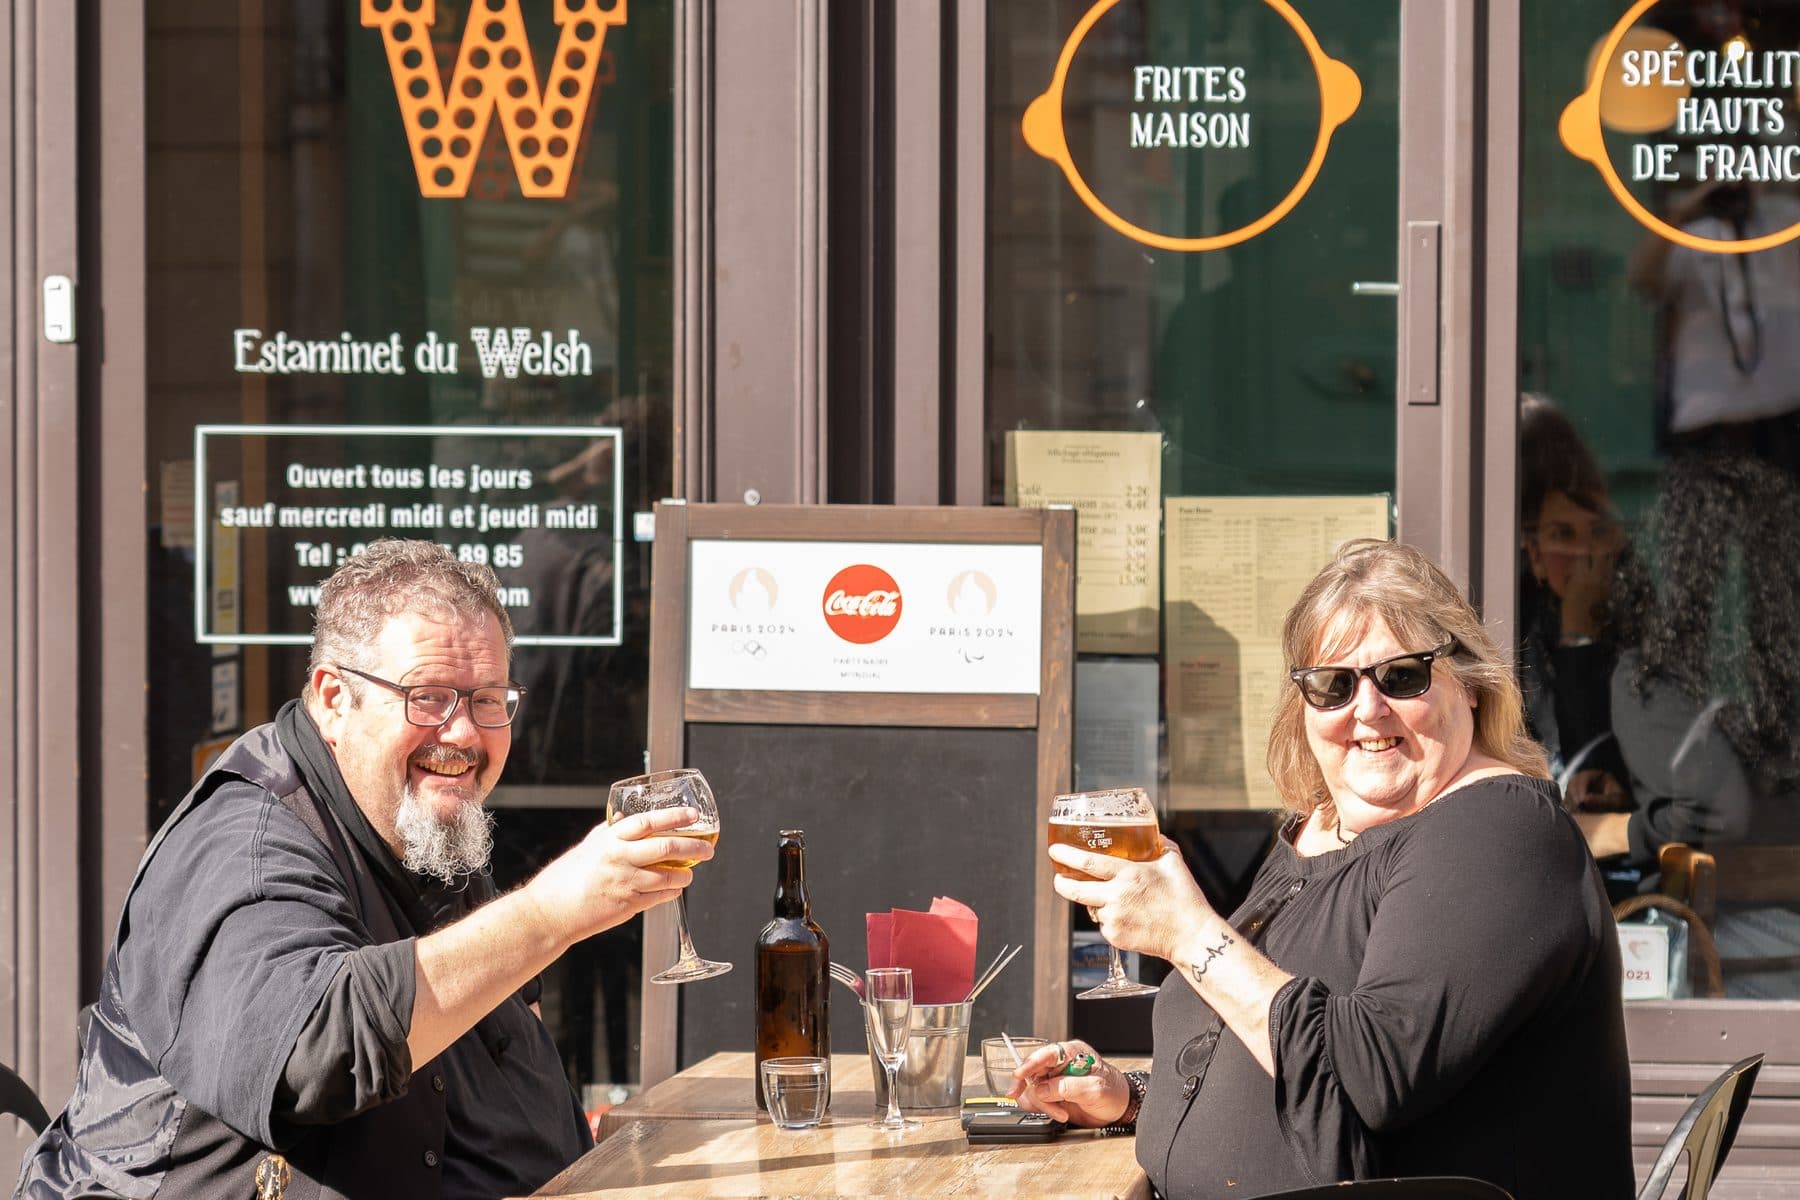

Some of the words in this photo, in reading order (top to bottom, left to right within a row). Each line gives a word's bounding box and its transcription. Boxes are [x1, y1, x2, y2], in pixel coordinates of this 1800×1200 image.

[1622, 42, 1800, 87] SPÉCIALIT
[360, 0, 628, 198] W
[1133, 65, 1247, 103] FRITES
[1130, 111, 1250, 149] MAISON
[1677, 97, 1785, 135] HAUTS
[1632, 143, 1680, 181] DE
[1696, 144, 1800, 182] FRANC
[233, 328, 406, 375] Estaminet
[415, 330, 459, 375] du
[470, 326, 593, 379] Welsh
[286, 463, 367, 489] Ouvert
[371, 465, 425, 489] tous
[430, 464, 466, 489] les
[469, 464, 533, 494] jours
[220, 502, 276, 528] sauf
[279, 503, 386, 528] mercredi
[391, 503, 444, 528] midi
[449, 505, 476, 529] et
[478, 503, 540, 533] jeudi
[545, 503, 598, 529] midi
[294, 542, 332, 567] Tel
[493, 544, 524, 568] 85
[711, 624, 752, 633] PARIS
[758, 624, 795, 634] 2024
[929, 626, 970, 637] PARIS
[976, 627, 1013, 638] 2024
[1625, 969, 1651, 981] 021
